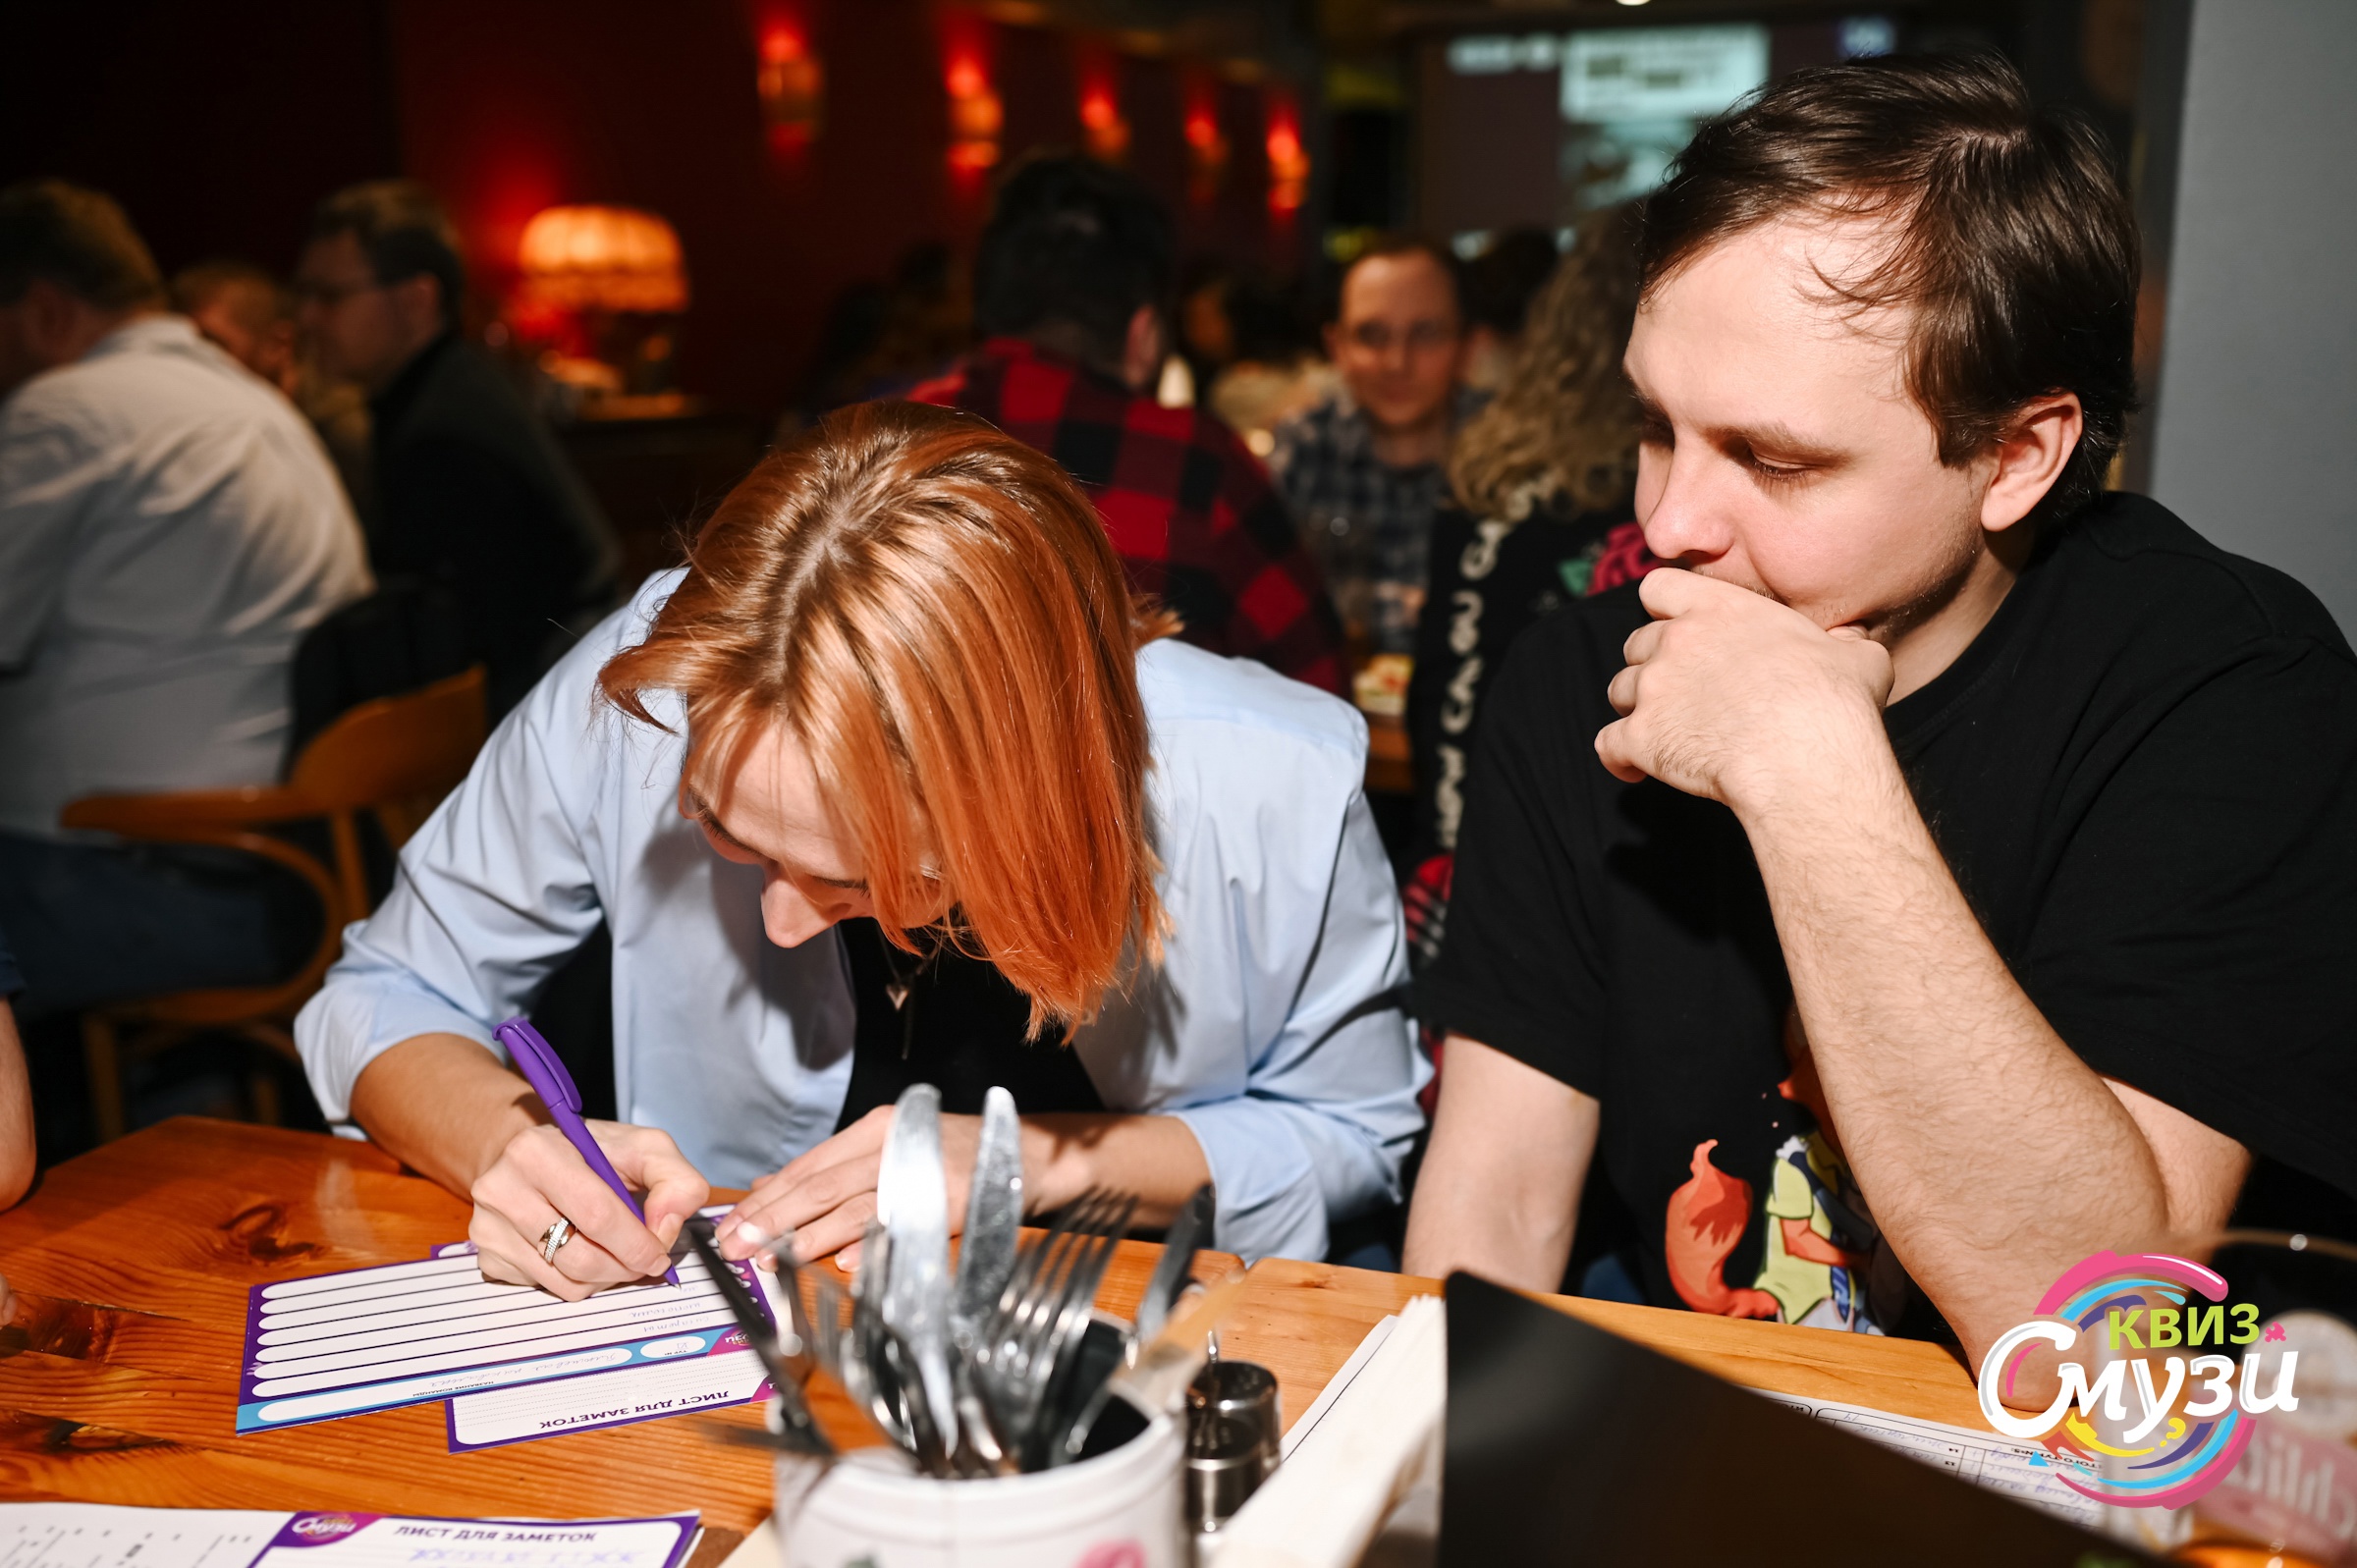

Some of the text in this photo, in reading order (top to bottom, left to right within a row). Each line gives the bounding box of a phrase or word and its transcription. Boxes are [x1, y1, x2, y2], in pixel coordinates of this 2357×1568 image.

[412, 1380, 494, 1397] НАЗВАНИЕ КОМАНДЫ
[539, 1390, 730, 1429] ЛИСТ ДЛЯ ЗАМЕТОК
[394, 1526, 598, 1542] ЛИСТ ДЛЯ ЗАМЕТОК
